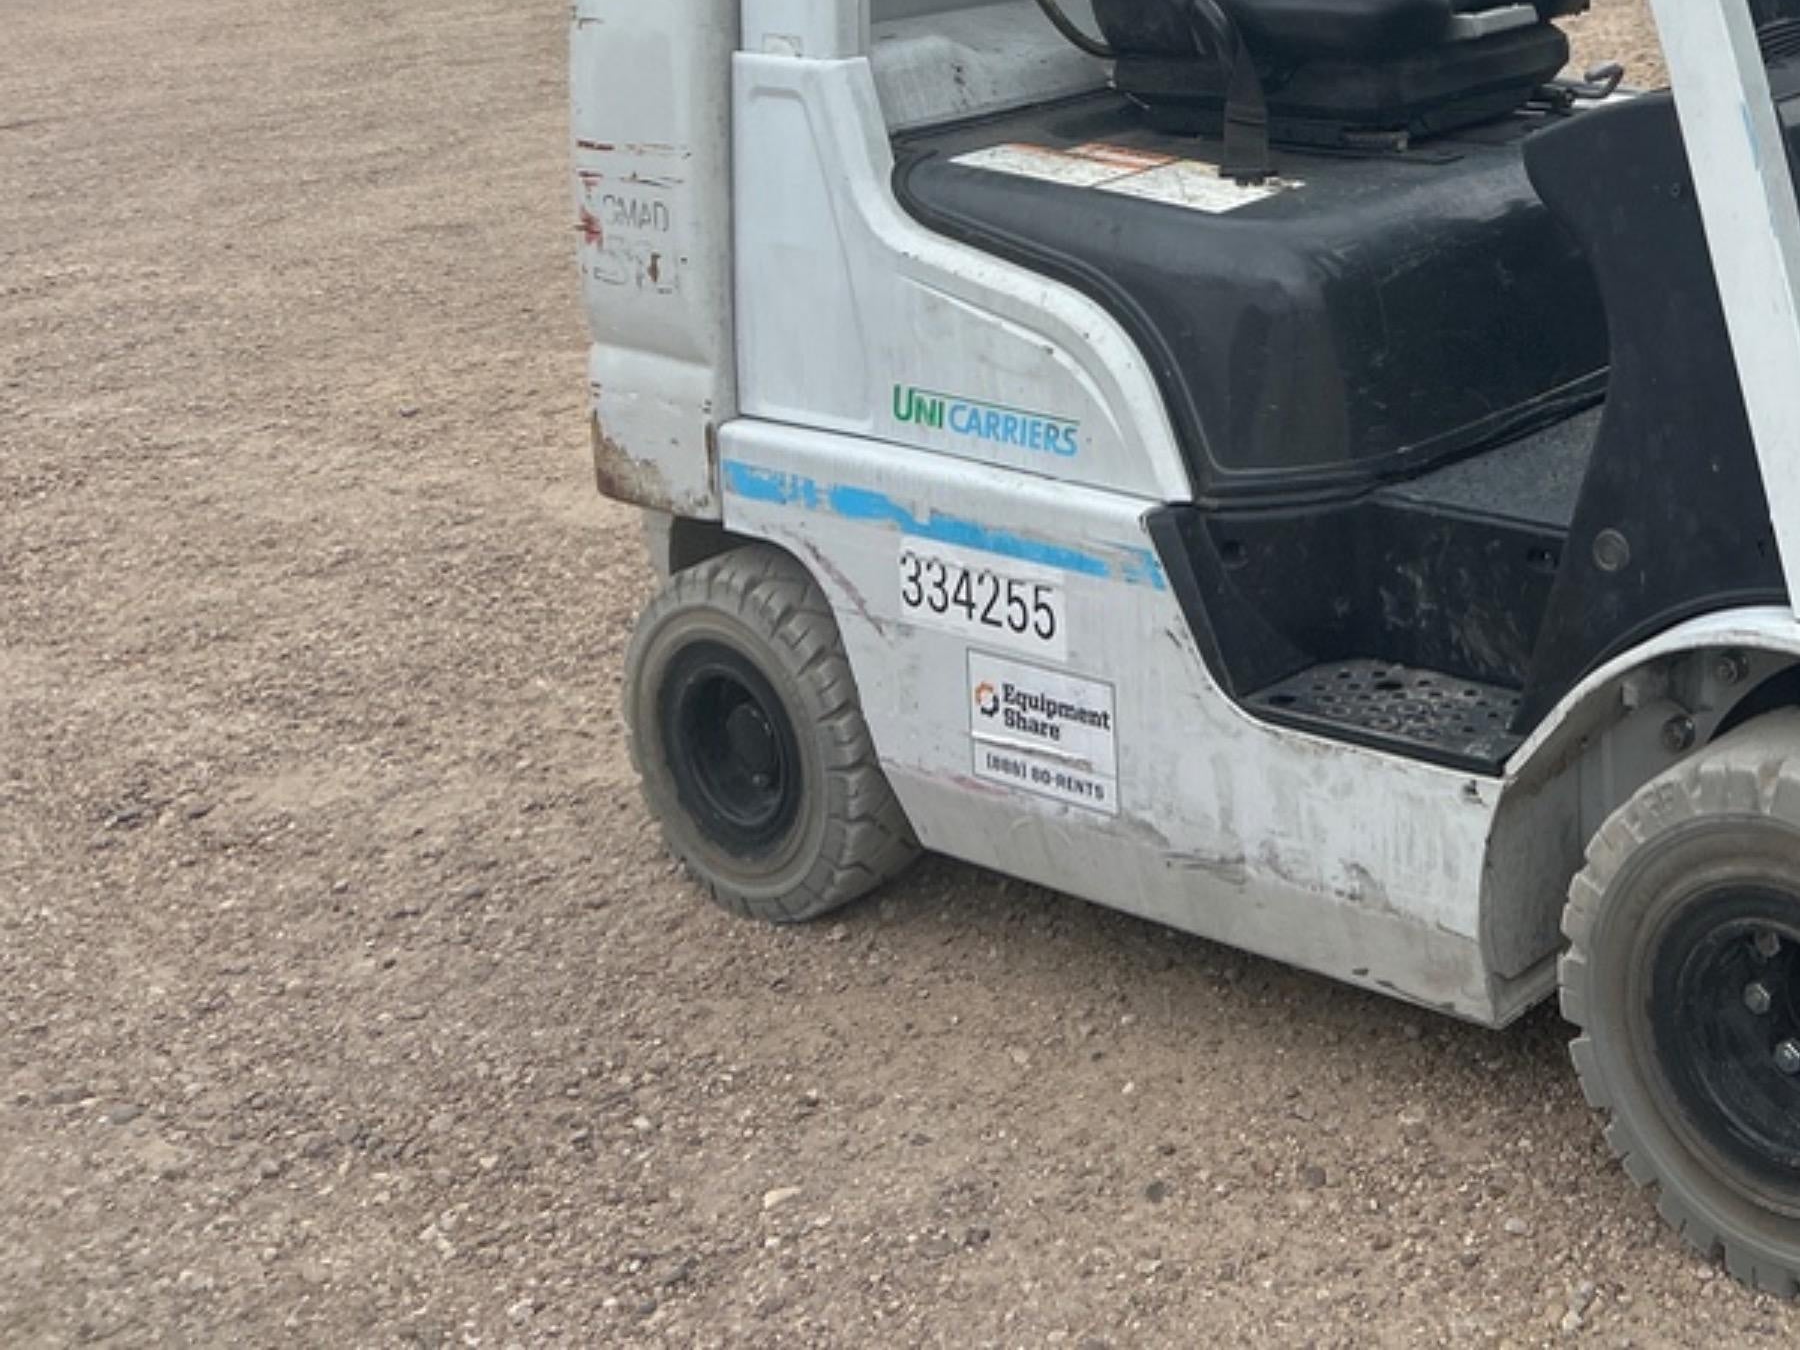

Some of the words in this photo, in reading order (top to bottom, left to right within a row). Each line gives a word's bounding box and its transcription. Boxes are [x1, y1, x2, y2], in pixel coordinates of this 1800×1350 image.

[901, 550, 1056, 640] 334255
[1002, 683, 1111, 730] Equipment
[1004, 708, 1061, 741] Share
